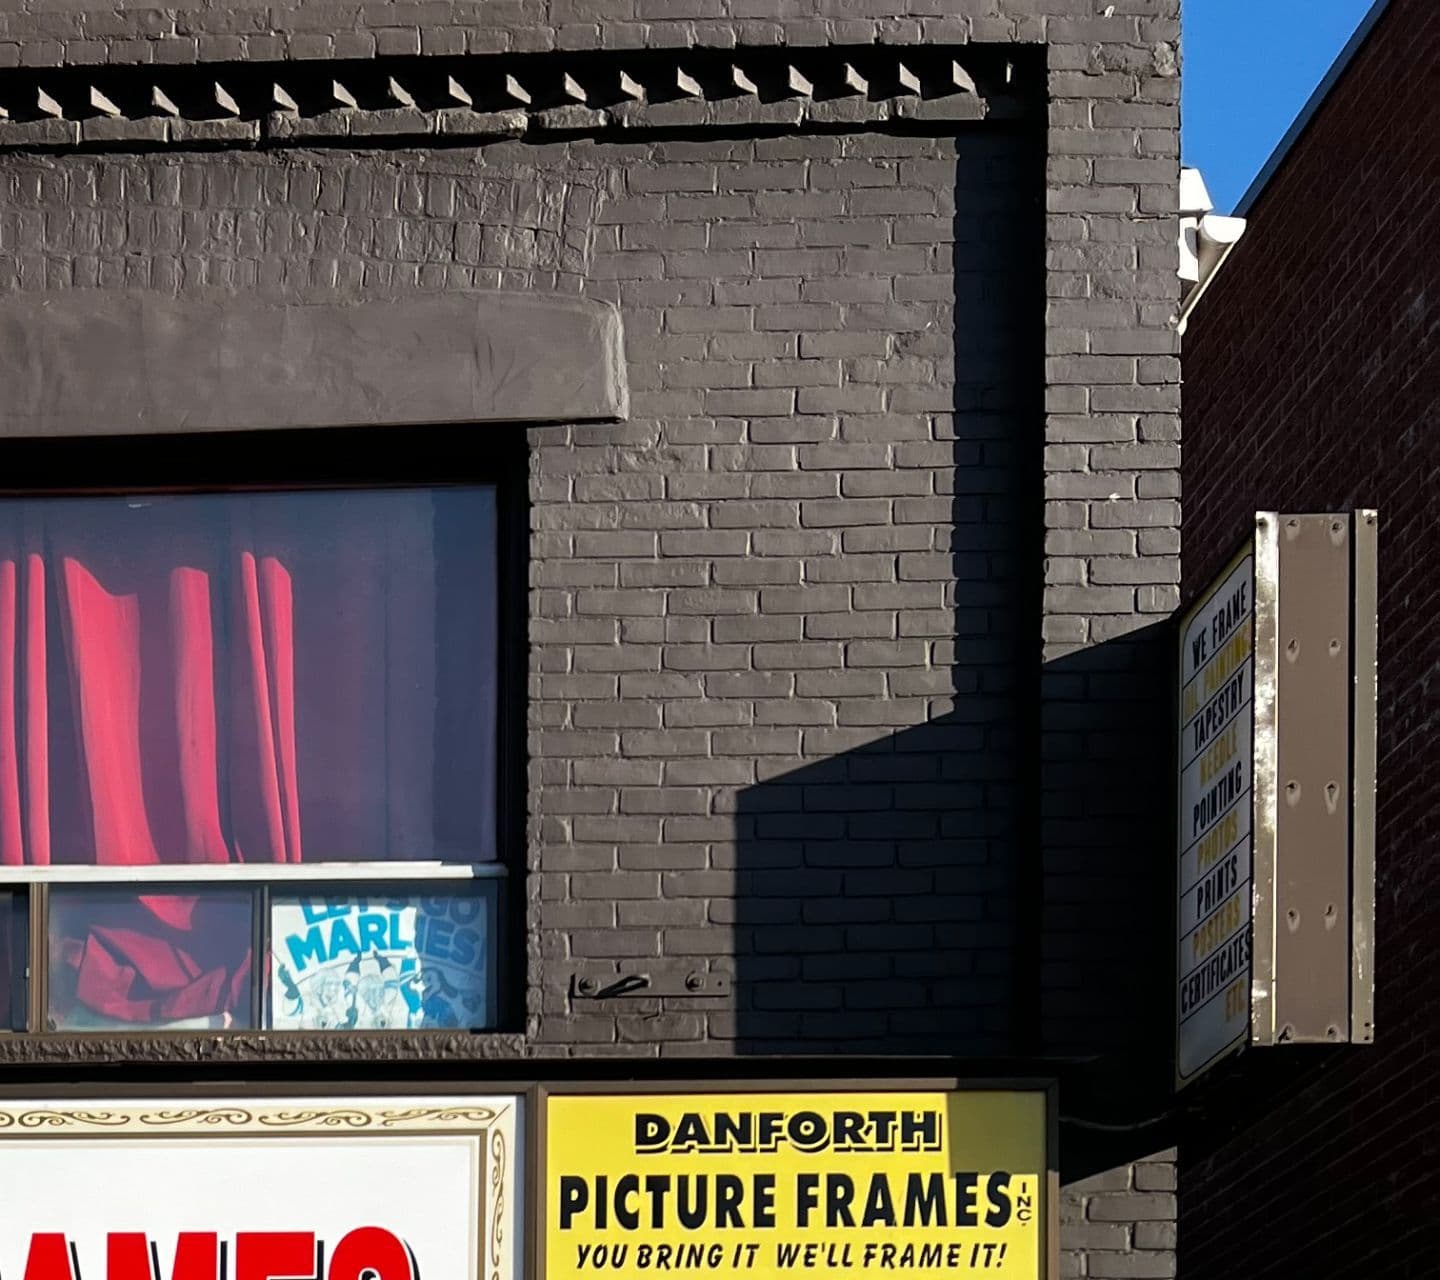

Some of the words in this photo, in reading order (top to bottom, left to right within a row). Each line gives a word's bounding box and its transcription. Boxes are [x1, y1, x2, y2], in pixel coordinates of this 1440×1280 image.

[1191, 625, 1208, 671] WE
[1212, 579, 1248, 650] FRAME
[1192, 669, 1245, 752] TAPESTRY
[1192, 760, 1243, 838] POINTING
[1196, 854, 1239, 920] PRINTS
[1180, 927, 1251, 1016] CERTIFICATES
[634, 1110, 943, 1155] DANFORTH
[559, 1173, 776, 1231] PICTURE
[796, 1170, 1013, 1229] FRAMES
[576, 1243, 628, 1270] YOU
[636, 1243, 724, 1271] BRING
[732, 1243, 760, 1270] IT
[776, 1242, 854, 1270] WE'LL
[863, 1242, 962, 1270] FRAME
[969, 1242, 1009, 1269] IT!
